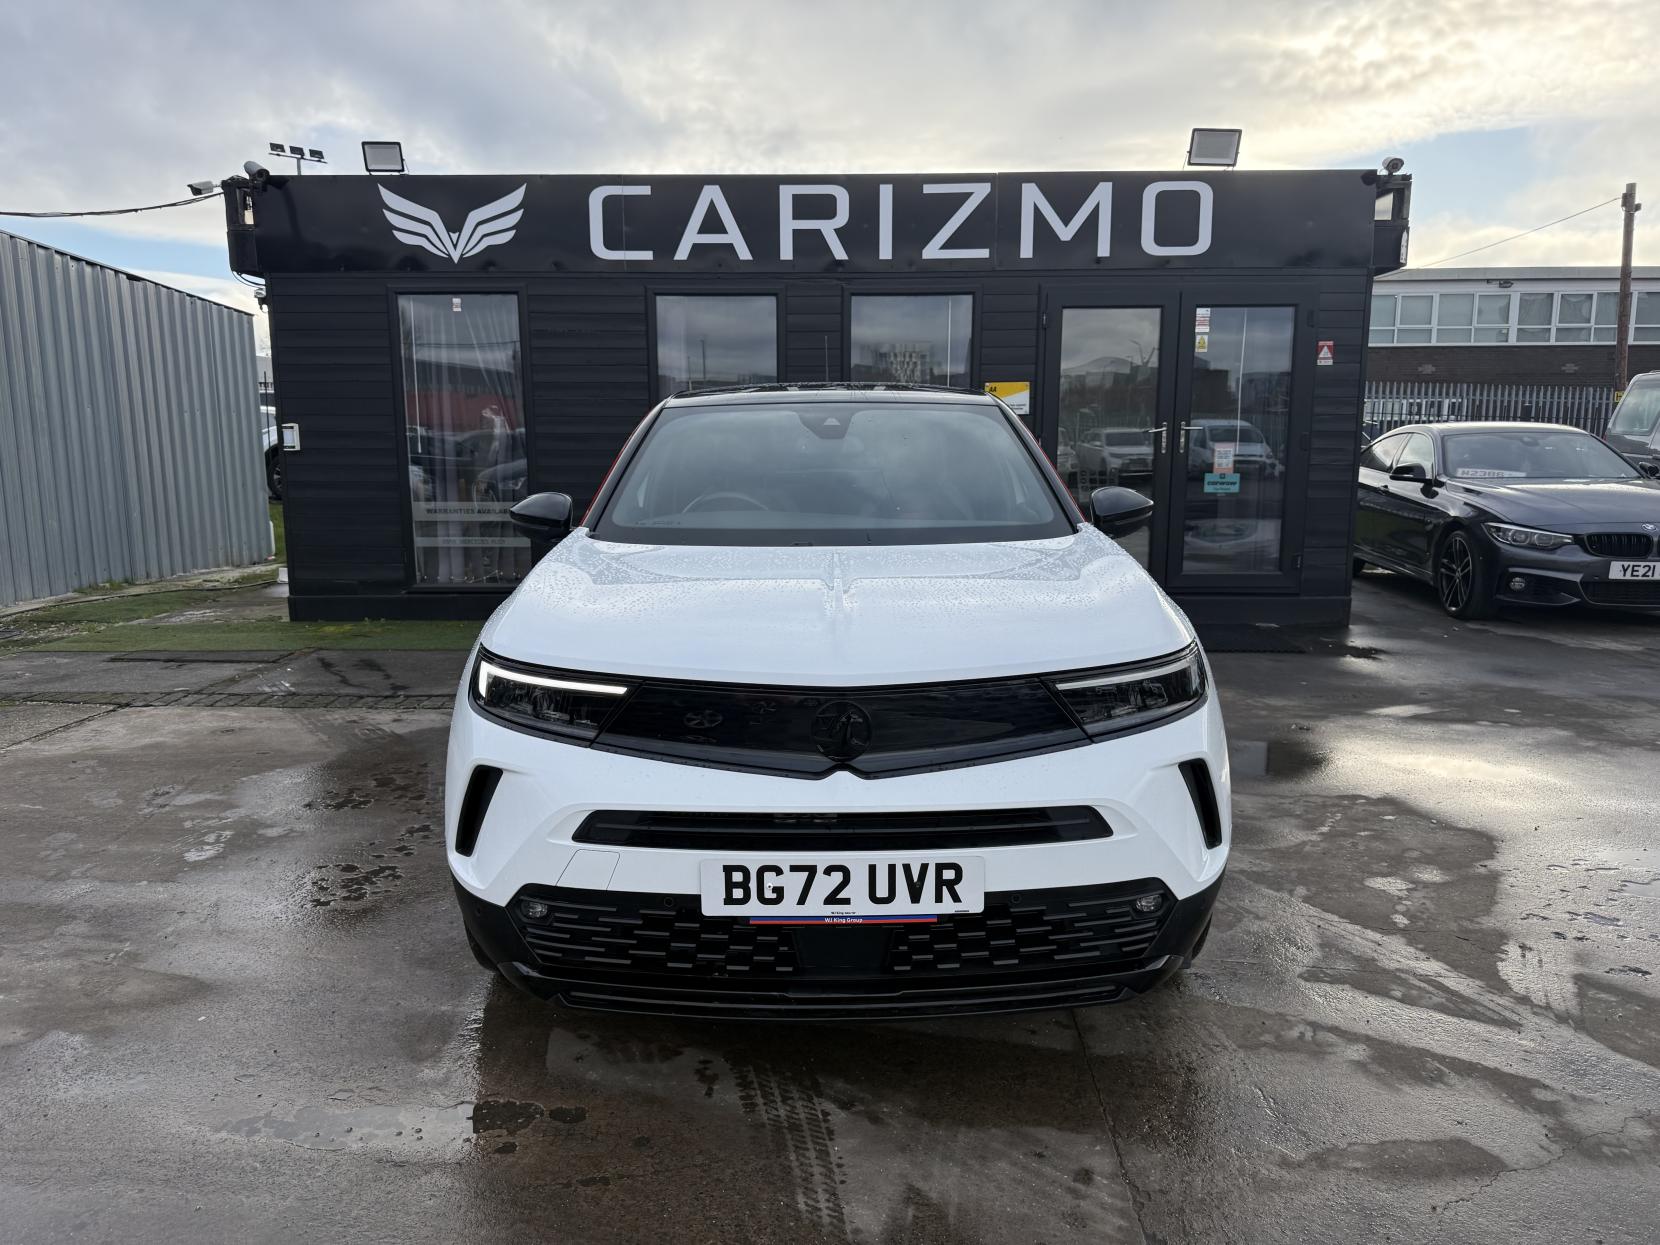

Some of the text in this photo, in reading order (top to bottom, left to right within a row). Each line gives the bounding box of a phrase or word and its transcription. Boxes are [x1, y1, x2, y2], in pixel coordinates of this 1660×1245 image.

[588, 180, 1214, 261] CARIZMO
[1621, 564, 1656, 578] YE21
[722, 862, 963, 906] BG72 UVR
